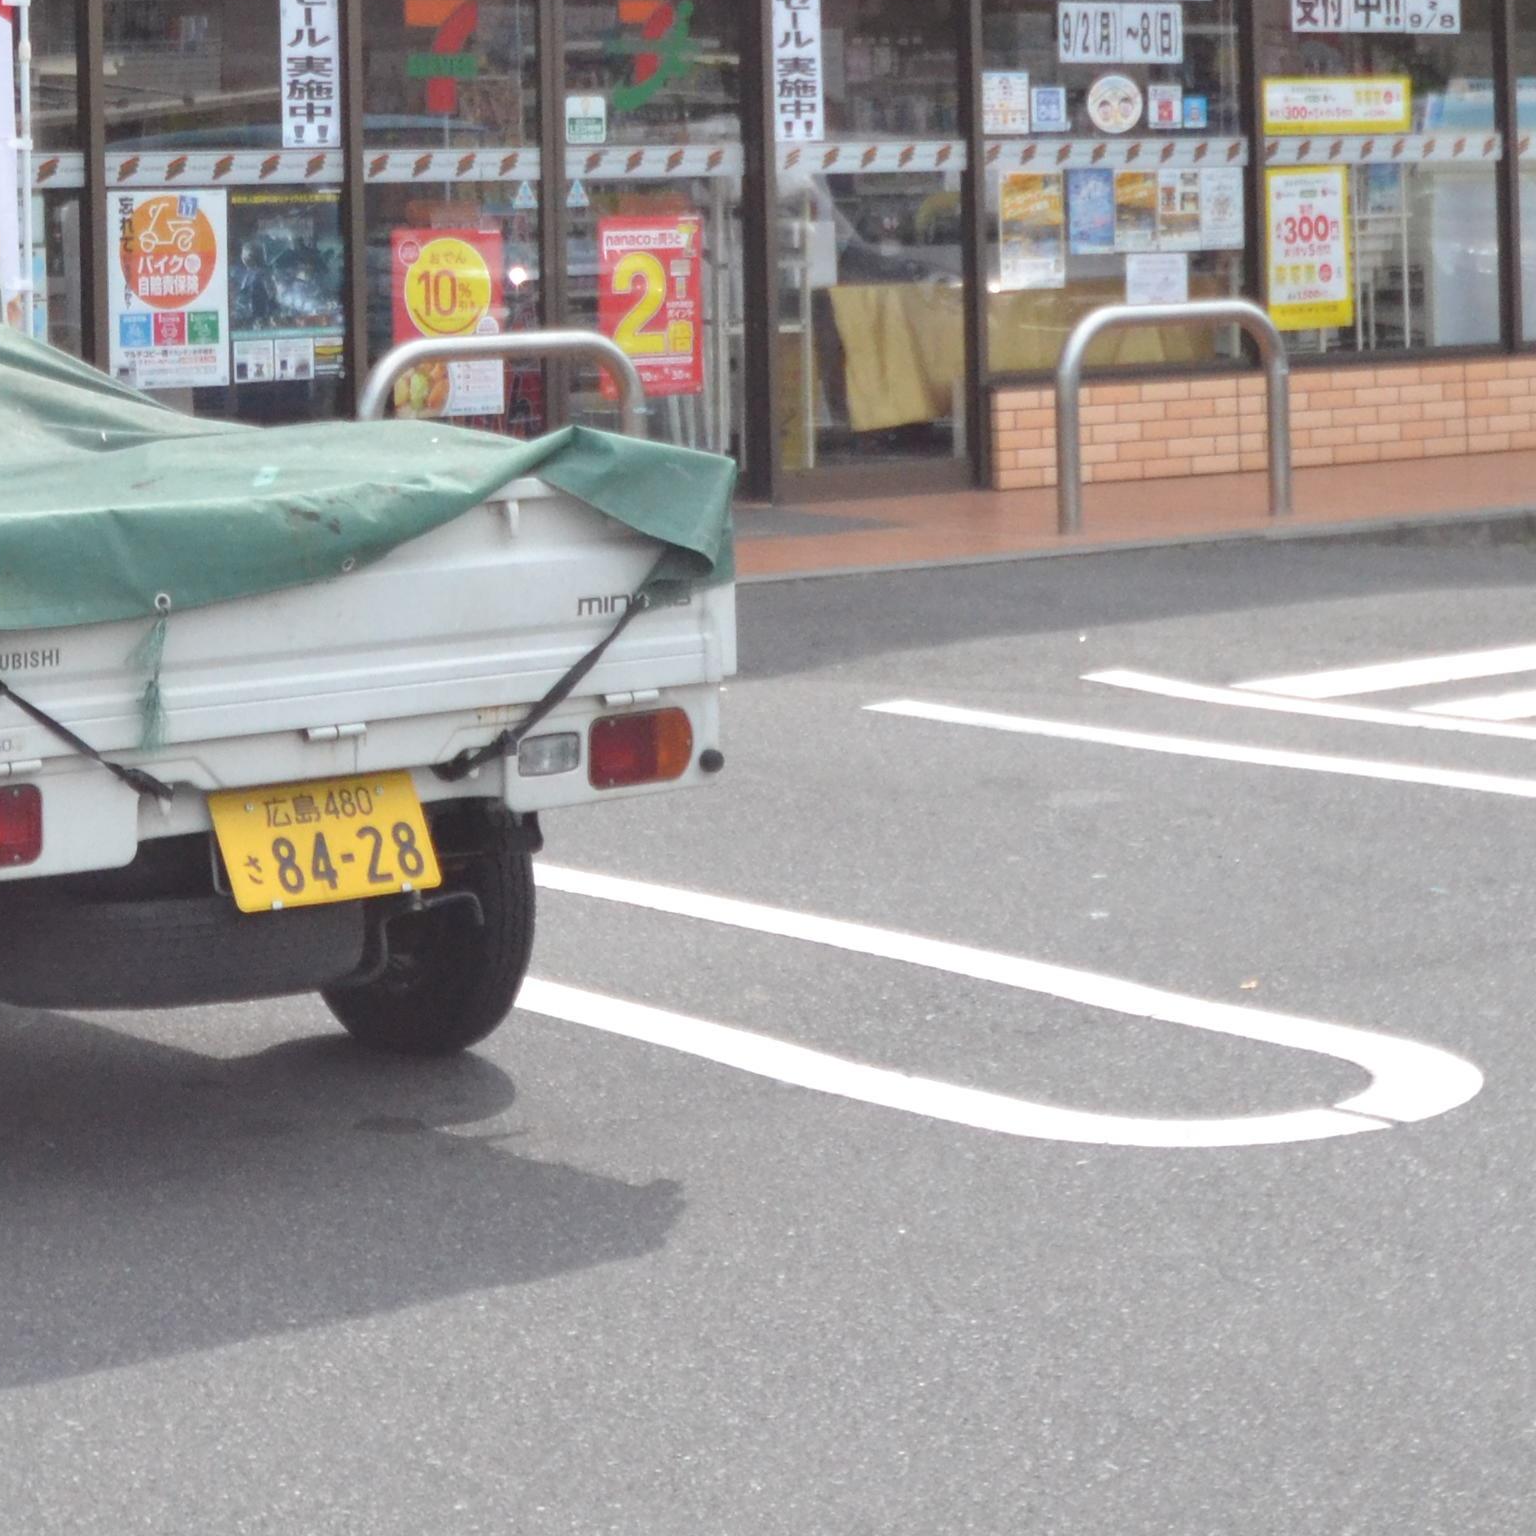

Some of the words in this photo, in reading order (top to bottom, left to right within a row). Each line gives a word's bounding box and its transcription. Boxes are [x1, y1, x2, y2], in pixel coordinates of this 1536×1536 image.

[262, 794, 321, 828] 広島
[324, 786, 374, 820] 480
[244, 854, 264, 885] さ
[271, 821, 425, 895] 84-28
